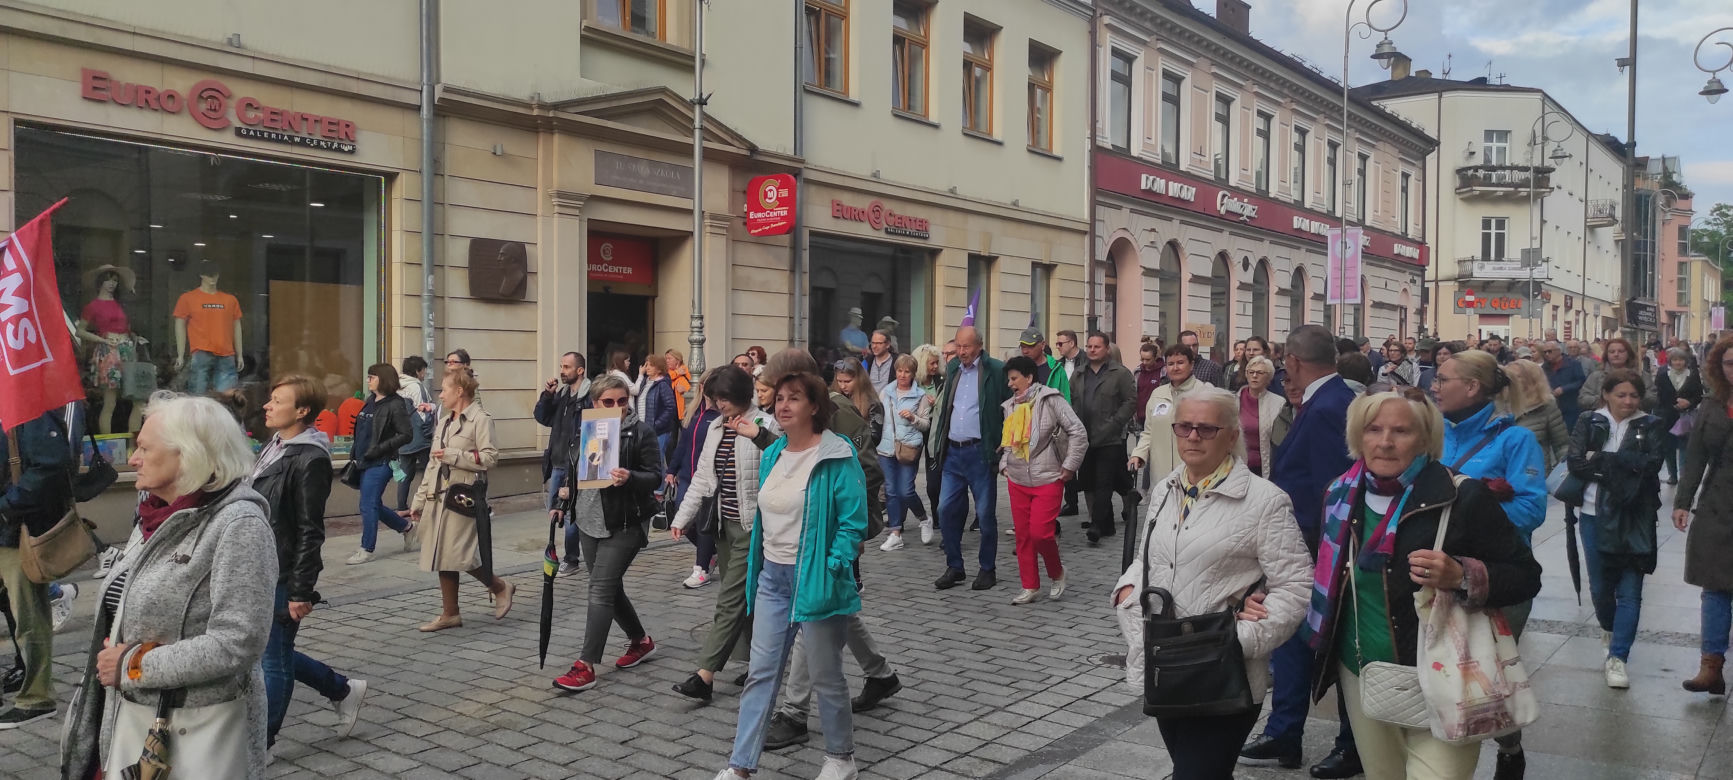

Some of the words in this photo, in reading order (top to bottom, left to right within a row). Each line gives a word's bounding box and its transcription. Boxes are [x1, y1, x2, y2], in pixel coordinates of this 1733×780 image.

[81, 67, 183, 114] EURO
[235, 97, 357, 142] CENTER
[241, 128, 289, 141] GALERIA
[305, 138, 353, 151] CENTRUM
[1140, 173, 1166, 195] DOM
[1168, 181, 1197, 202] MODY
[832, 199, 867, 223] EURO
[884, 209, 931, 233] CENTER
[587, 263, 633, 275] UROCENTER
[1457, 297, 1487, 308] CTY
